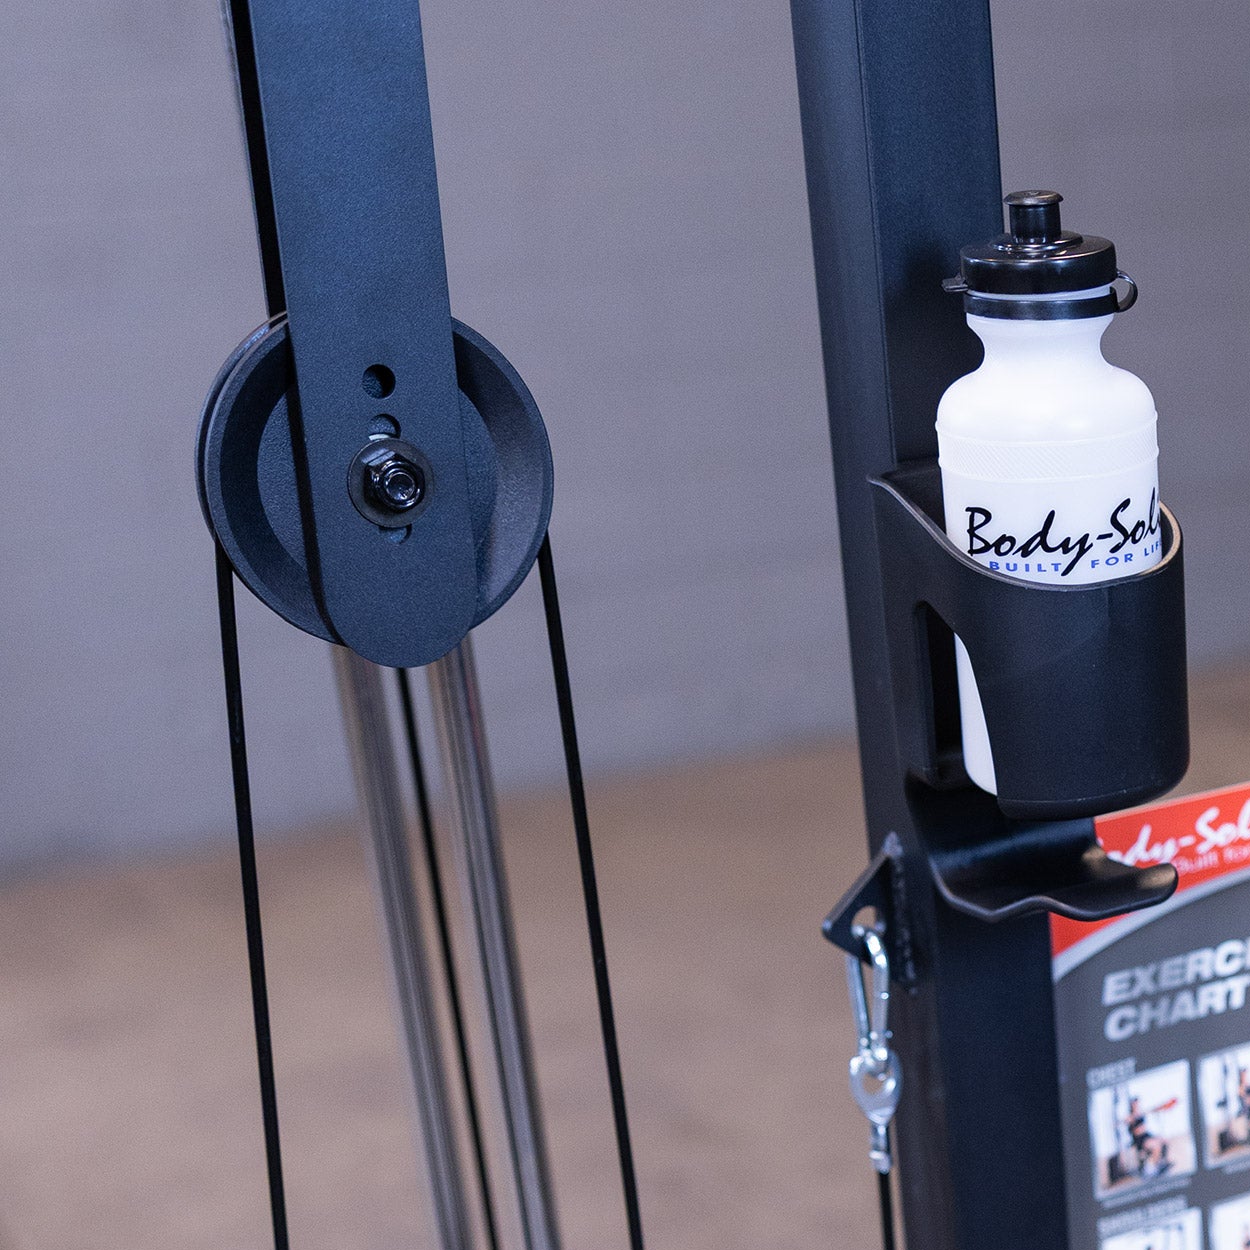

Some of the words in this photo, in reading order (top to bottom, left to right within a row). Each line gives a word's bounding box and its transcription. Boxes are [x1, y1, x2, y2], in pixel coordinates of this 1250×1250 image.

[965, 487, 1160, 576] Body-Sol
[989, 560, 1062, 573] BUILT
[1091, 552, 1133, 569] FOR
[1143, 540, 1160, 556] LIF
